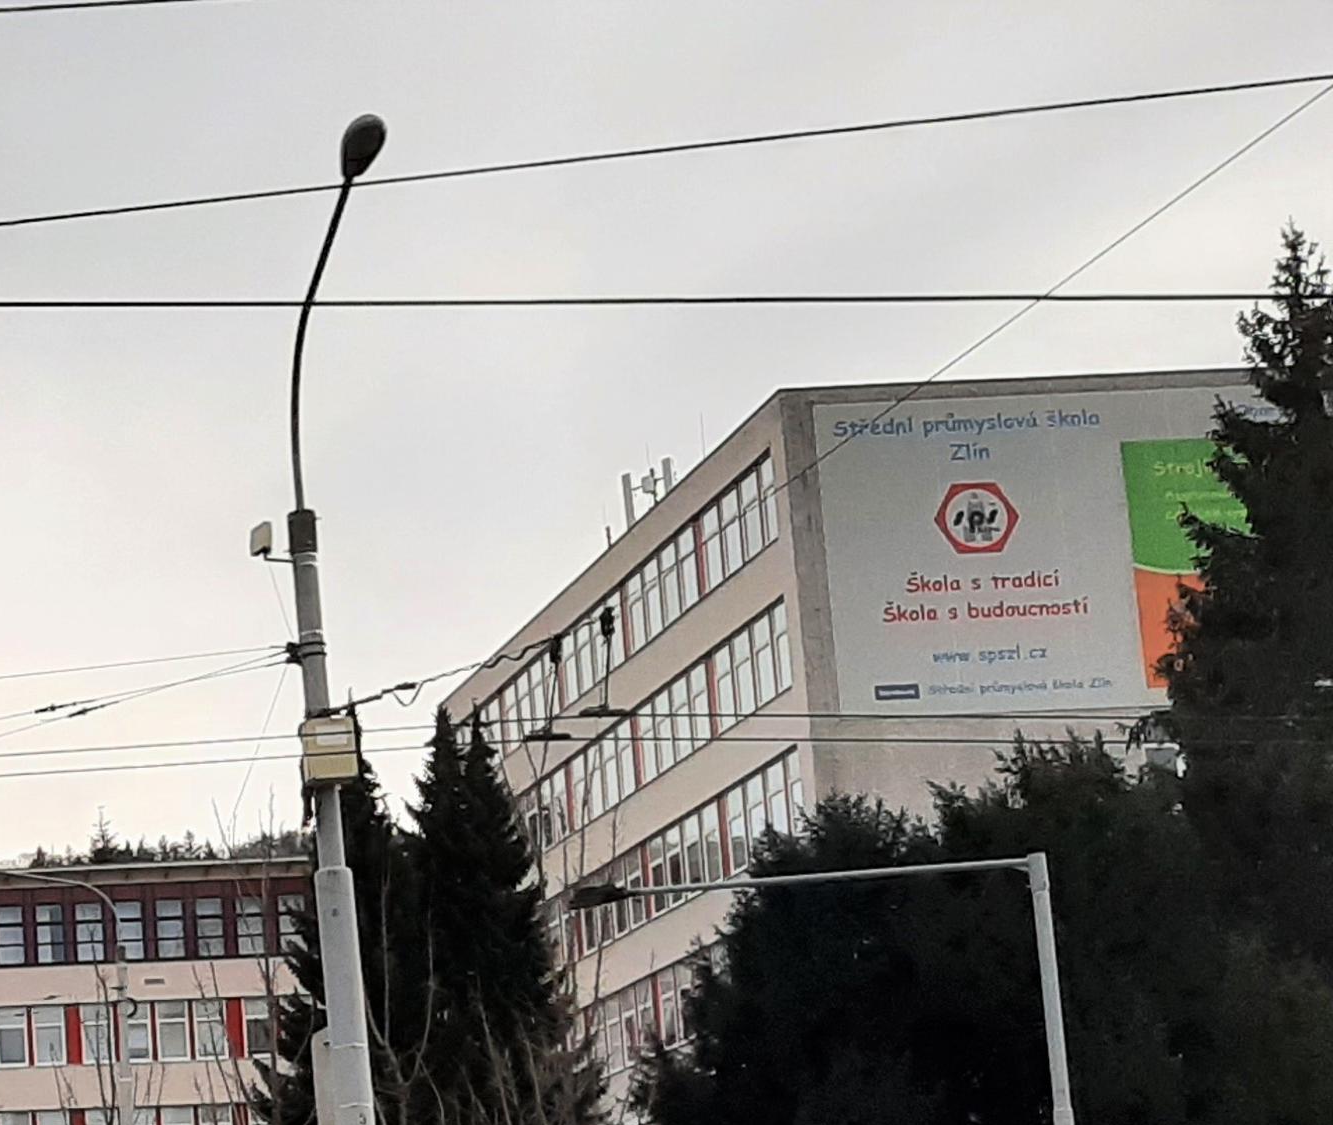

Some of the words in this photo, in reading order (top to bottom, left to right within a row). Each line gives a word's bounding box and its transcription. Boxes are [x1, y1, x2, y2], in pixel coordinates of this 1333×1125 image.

[833, 415, 913, 438] Střední
[922, 411, 1038, 438] průmyslová
[1046, 408, 1101, 427] škola
[949, 442, 991, 461] Zlín
[905, 571, 961, 594] Škola
[971, 576, 981, 590] s
[991, 568, 1060, 590] tradicí
[883, 601, 939, 623] Škola
[947, 606, 958, 620] s
[967, 596, 1089, 619] budoucností
